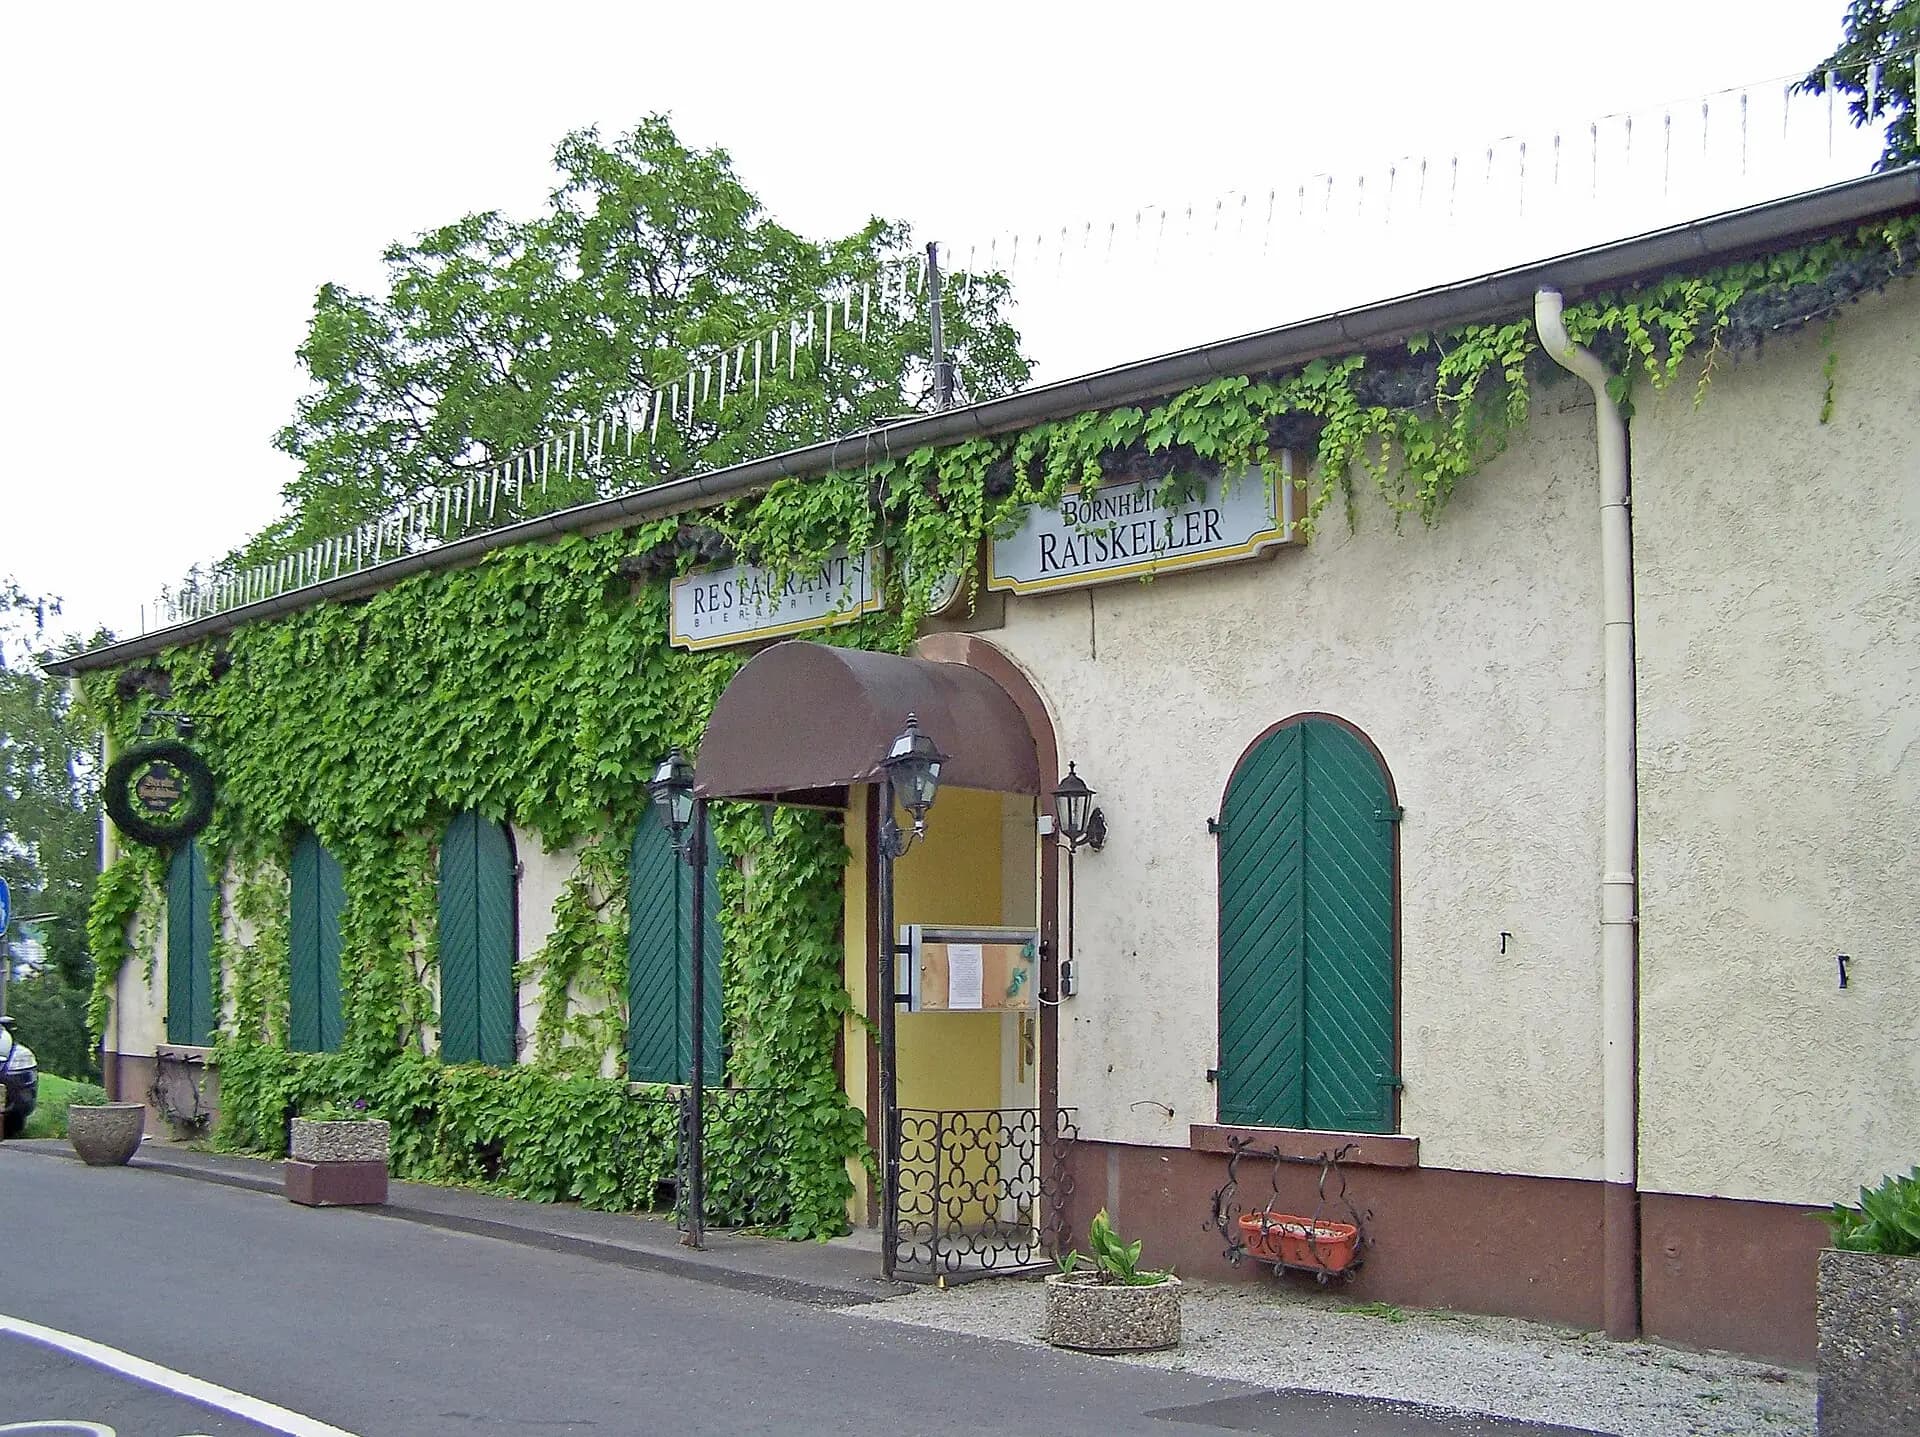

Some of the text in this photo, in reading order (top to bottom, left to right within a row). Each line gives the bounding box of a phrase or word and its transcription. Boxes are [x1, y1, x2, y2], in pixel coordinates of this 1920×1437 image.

[1063, 484, 1195, 527] BORNHEIR
[1039, 508, 1223, 573] RATSKELLER
[694, 588, 851, 628] BIERGRTE
